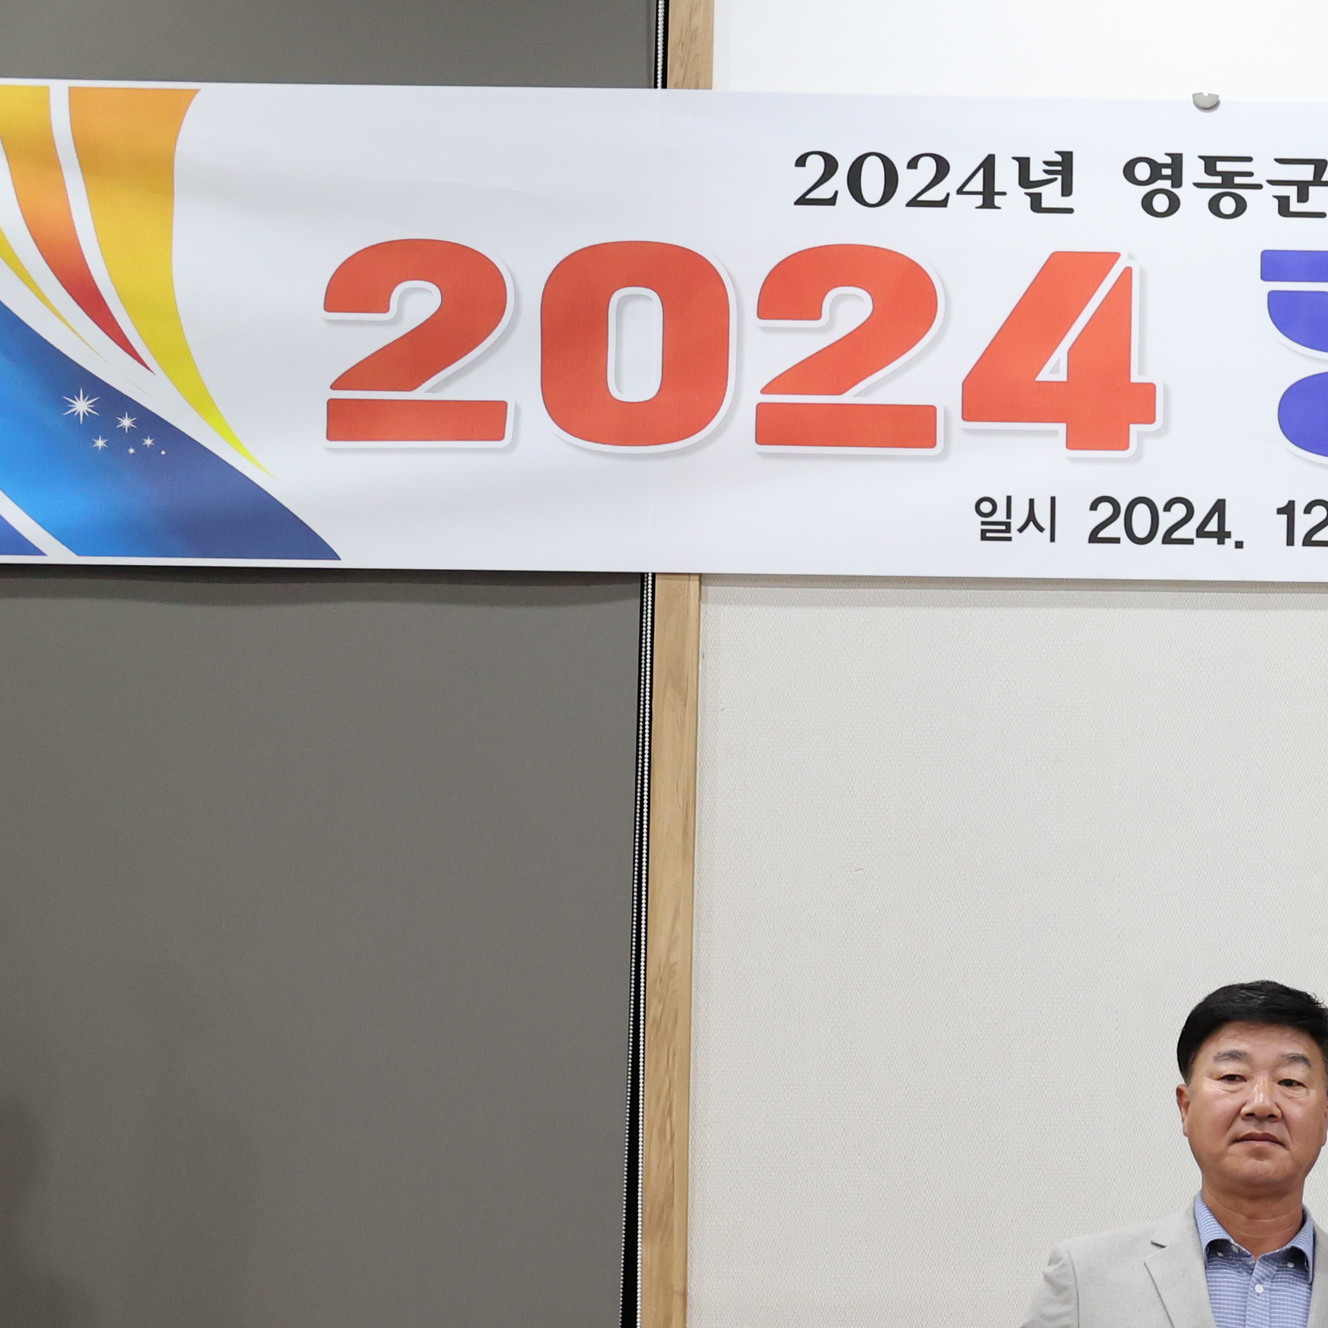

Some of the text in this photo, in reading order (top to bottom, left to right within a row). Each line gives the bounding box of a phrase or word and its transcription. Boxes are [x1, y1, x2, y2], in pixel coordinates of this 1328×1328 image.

[793, 150, 1075, 215] 2024년
[324, 239, 1155, 450] 2024
[974, 495, 1056, 543] 일시
[1087, 495, 1244, 550] 2024.
